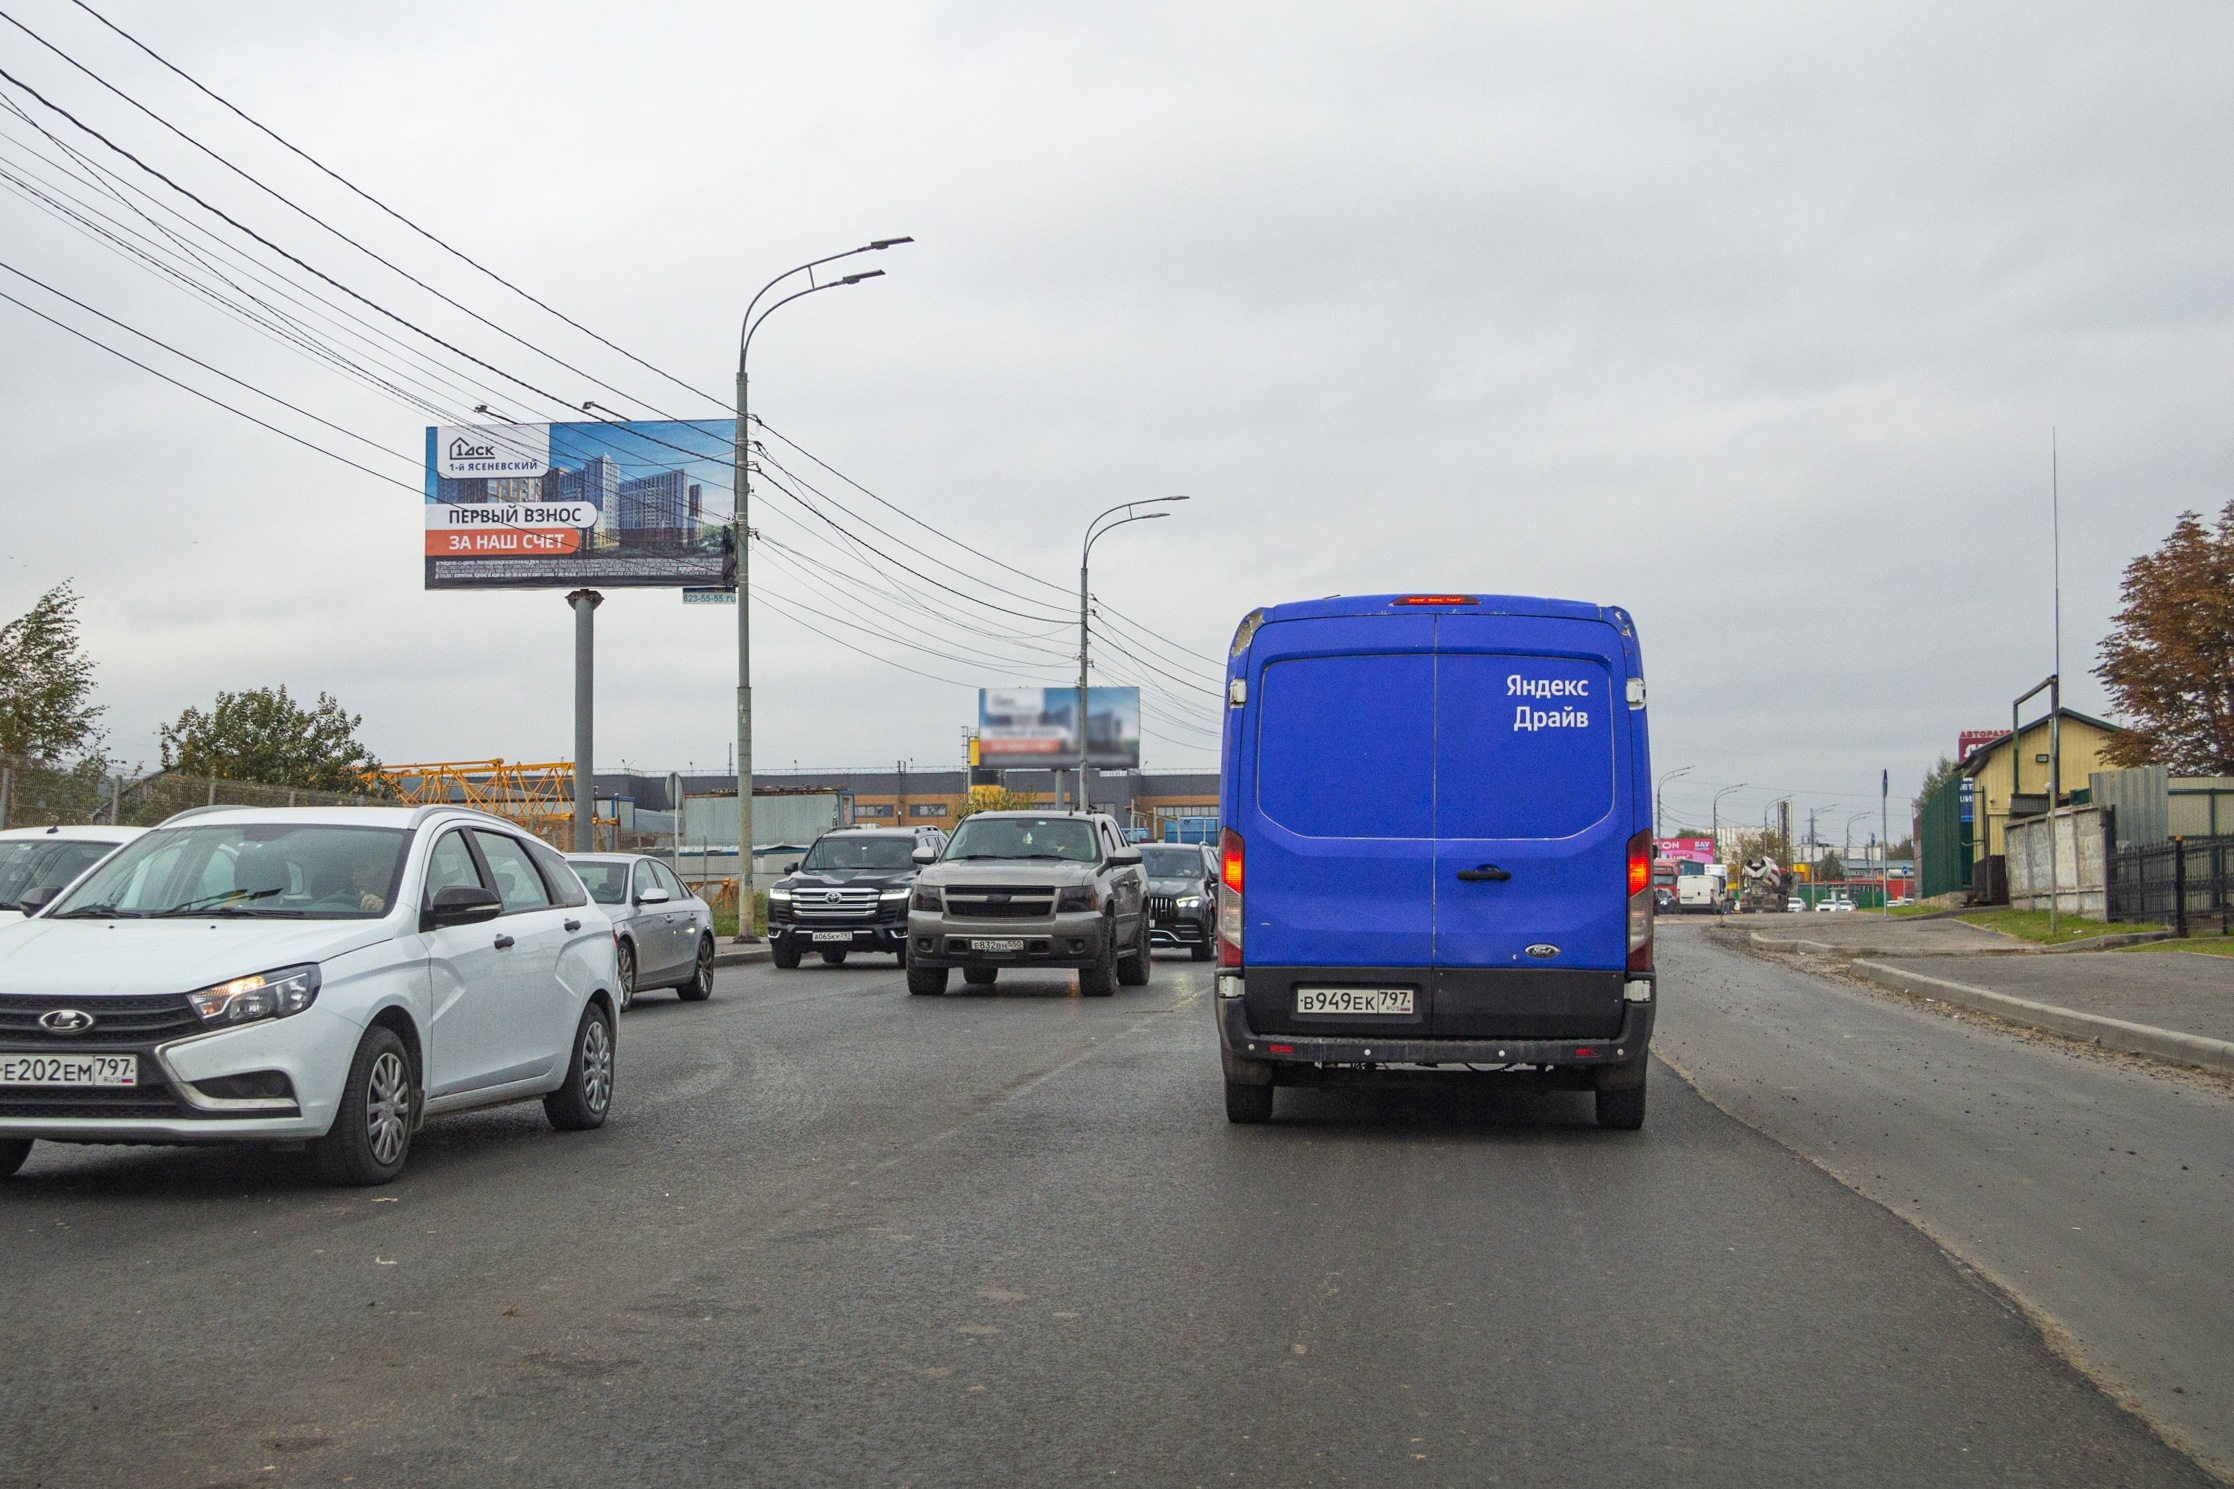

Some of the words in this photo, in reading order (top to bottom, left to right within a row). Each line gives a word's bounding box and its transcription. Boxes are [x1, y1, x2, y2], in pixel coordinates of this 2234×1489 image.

[468, 459, 538, 471] ЯСЕНЕВСКИЙ
[449, 505, 518, 524] ПЕРВЫЙ
[524, 508, 582, 523] ВЗНОС
[449, 535, 471, 550] ЗА
[476, 534, 517, 549] НАШ
[522, 534, 565, 548] СЧЕТ
[1506, 674, 1589, 699] Яндекс
[1513, 706, 1589, 732] Драйв
[1304, 992, 1375, 1011] В949ЕК
[1379, 992, 1408, 1006] 797
[4, 1059, 92, 1082] Е202ЕМ
[96, 1058, 130, 1076] 797
